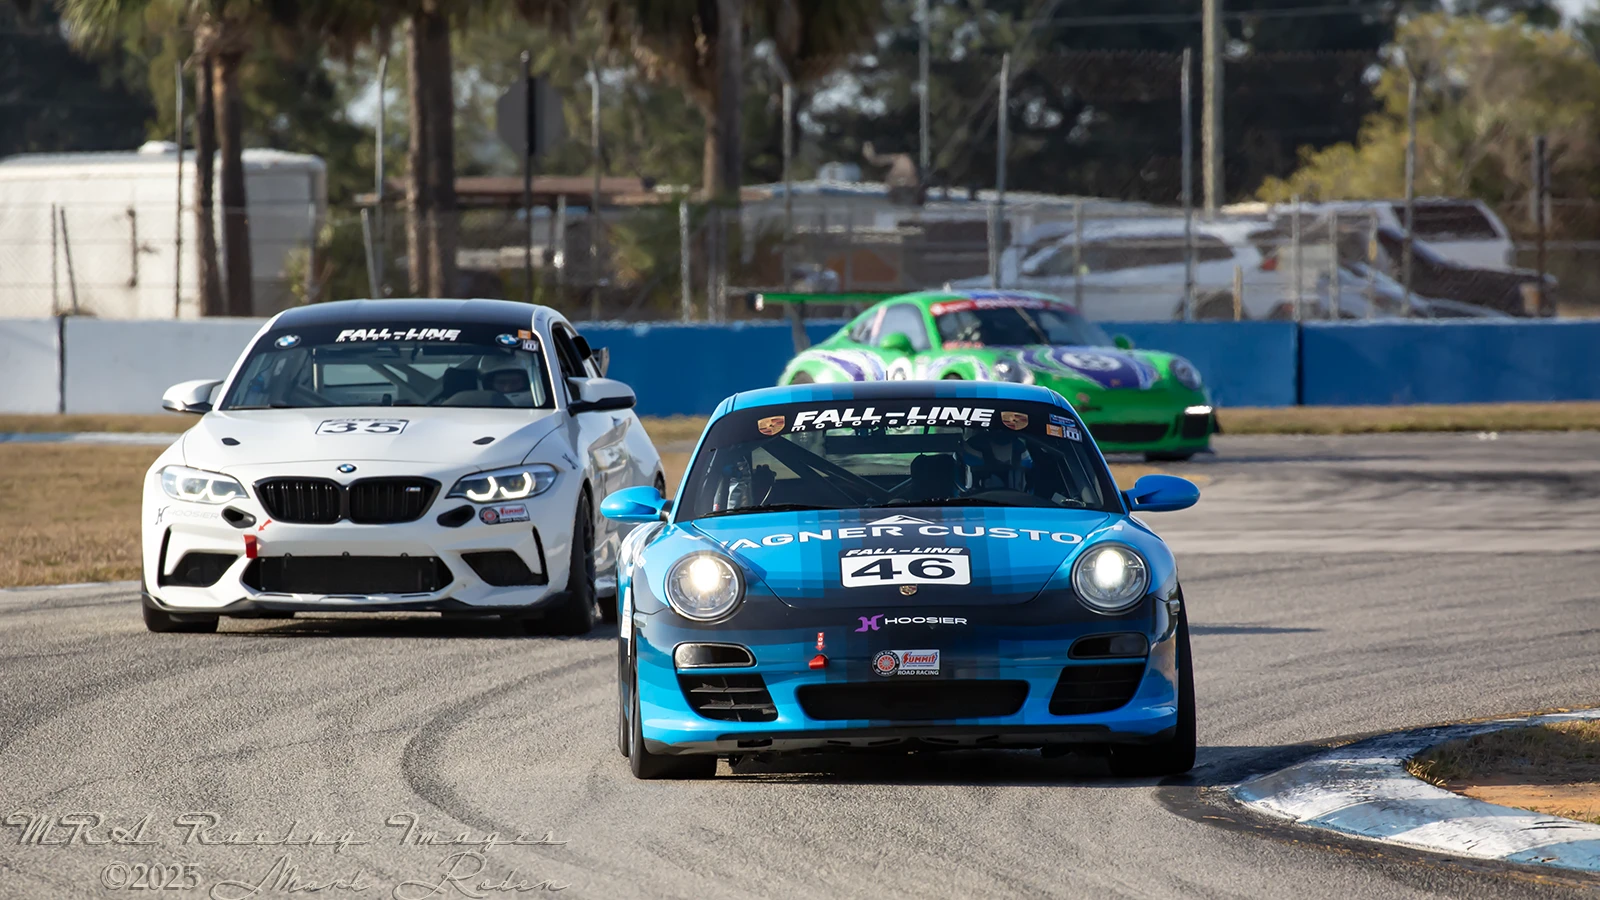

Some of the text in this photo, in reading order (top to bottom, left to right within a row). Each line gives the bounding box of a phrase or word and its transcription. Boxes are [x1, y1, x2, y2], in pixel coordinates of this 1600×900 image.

[336, 328, 461, 341] FALL-LINE
[793, 407, 995, 427] FALL-LINE
[322, 422, 401, 434] 35
[791, 418, 991, 432] motorsports
[845, 547, 963, 556] FALL-LINE
[850, 557, 956, 580] 46
[884, 616, 967, 625] HOOSIER
